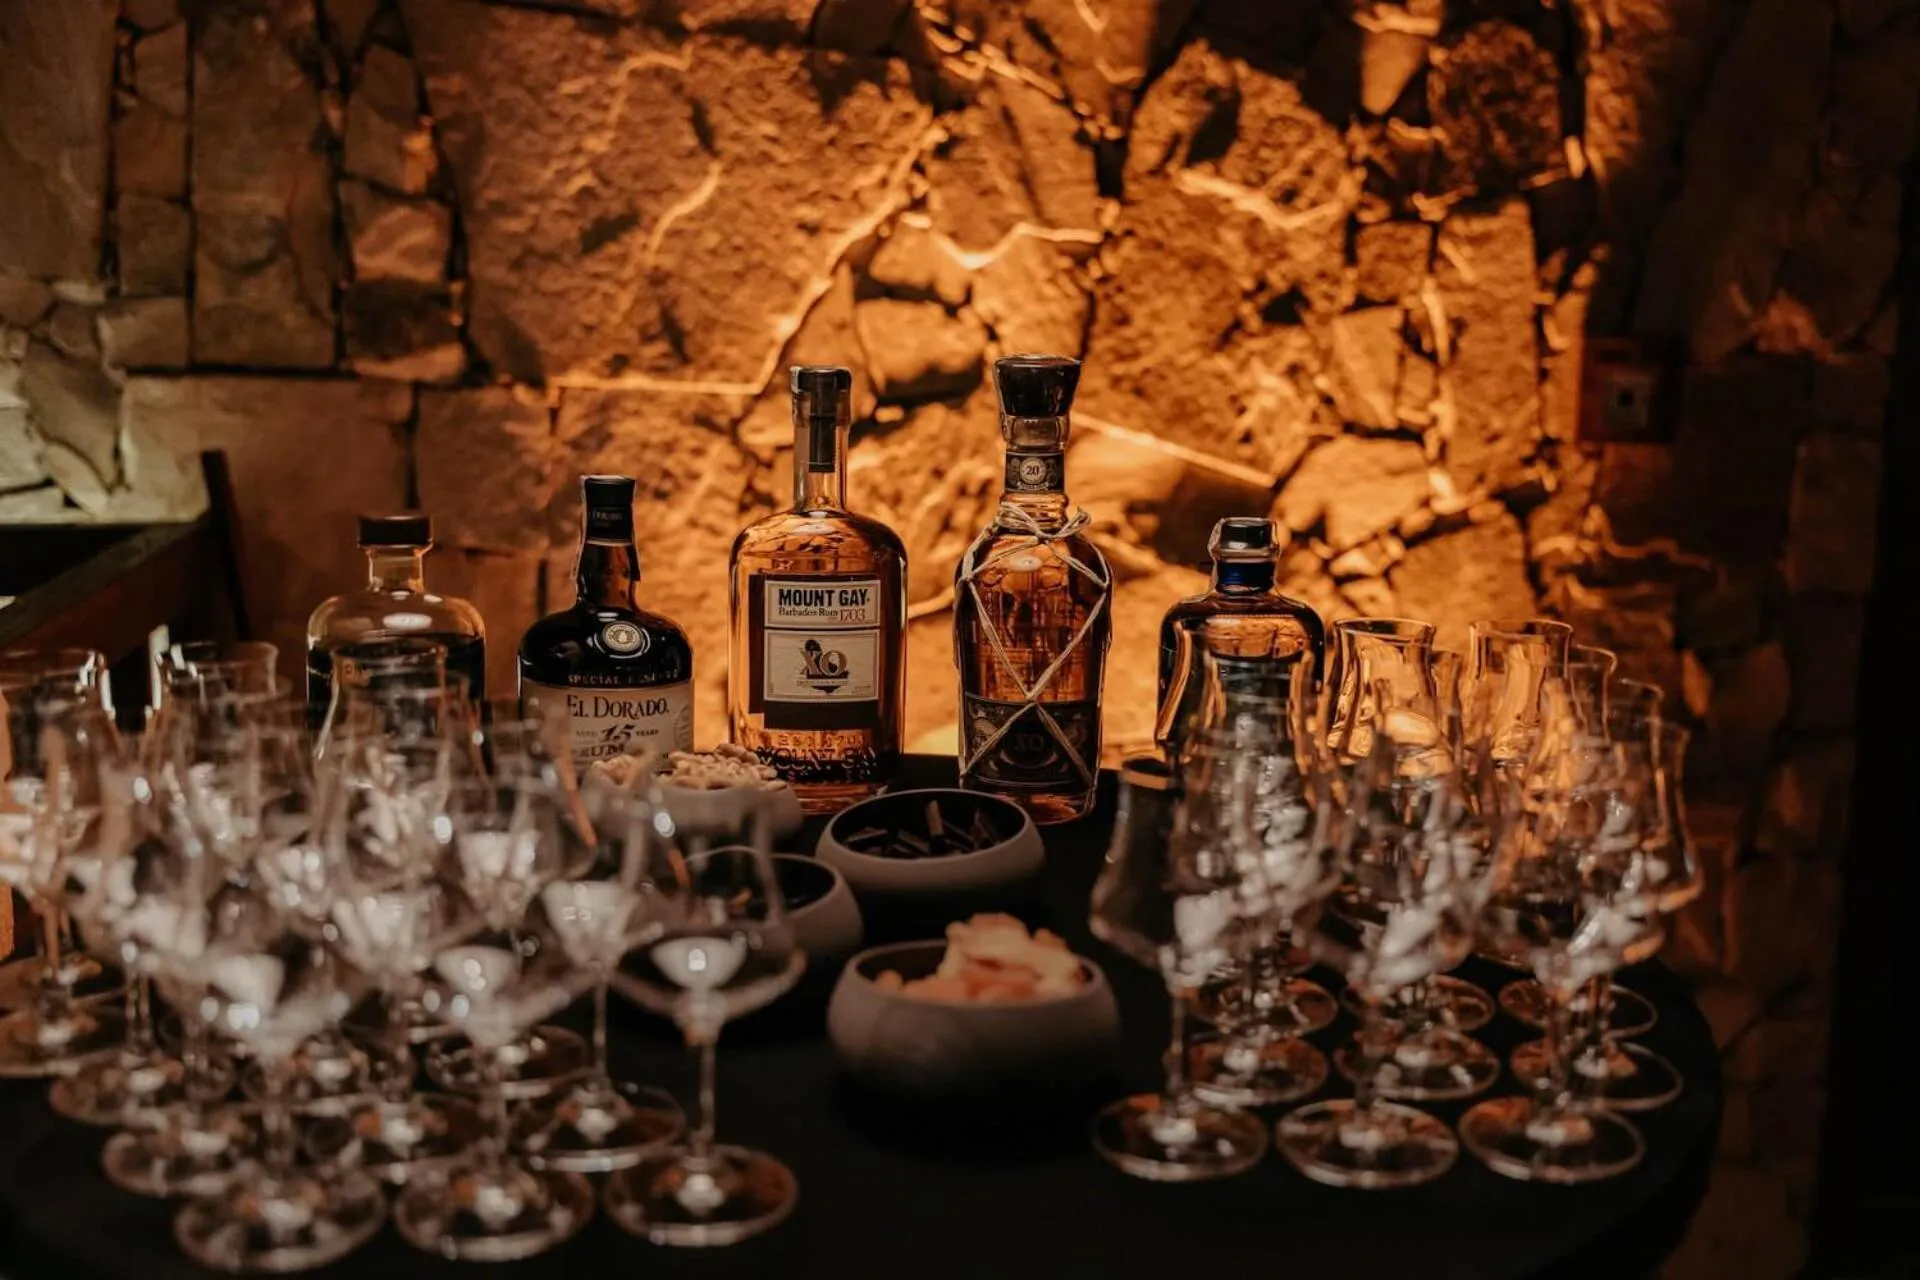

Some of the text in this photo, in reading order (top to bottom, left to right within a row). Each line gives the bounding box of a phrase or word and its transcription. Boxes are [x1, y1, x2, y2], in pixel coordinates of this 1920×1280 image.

[1025, 465, 1040, 475] 20
[778, 588, 869, 607] MOUNT GAY
[779, 606, 866, 621] Barbados Rum 1703
[567, 694, 588, 717] EL
[602, 724, 636, 743] 15
[636, 729, 659, 737] YEARS
